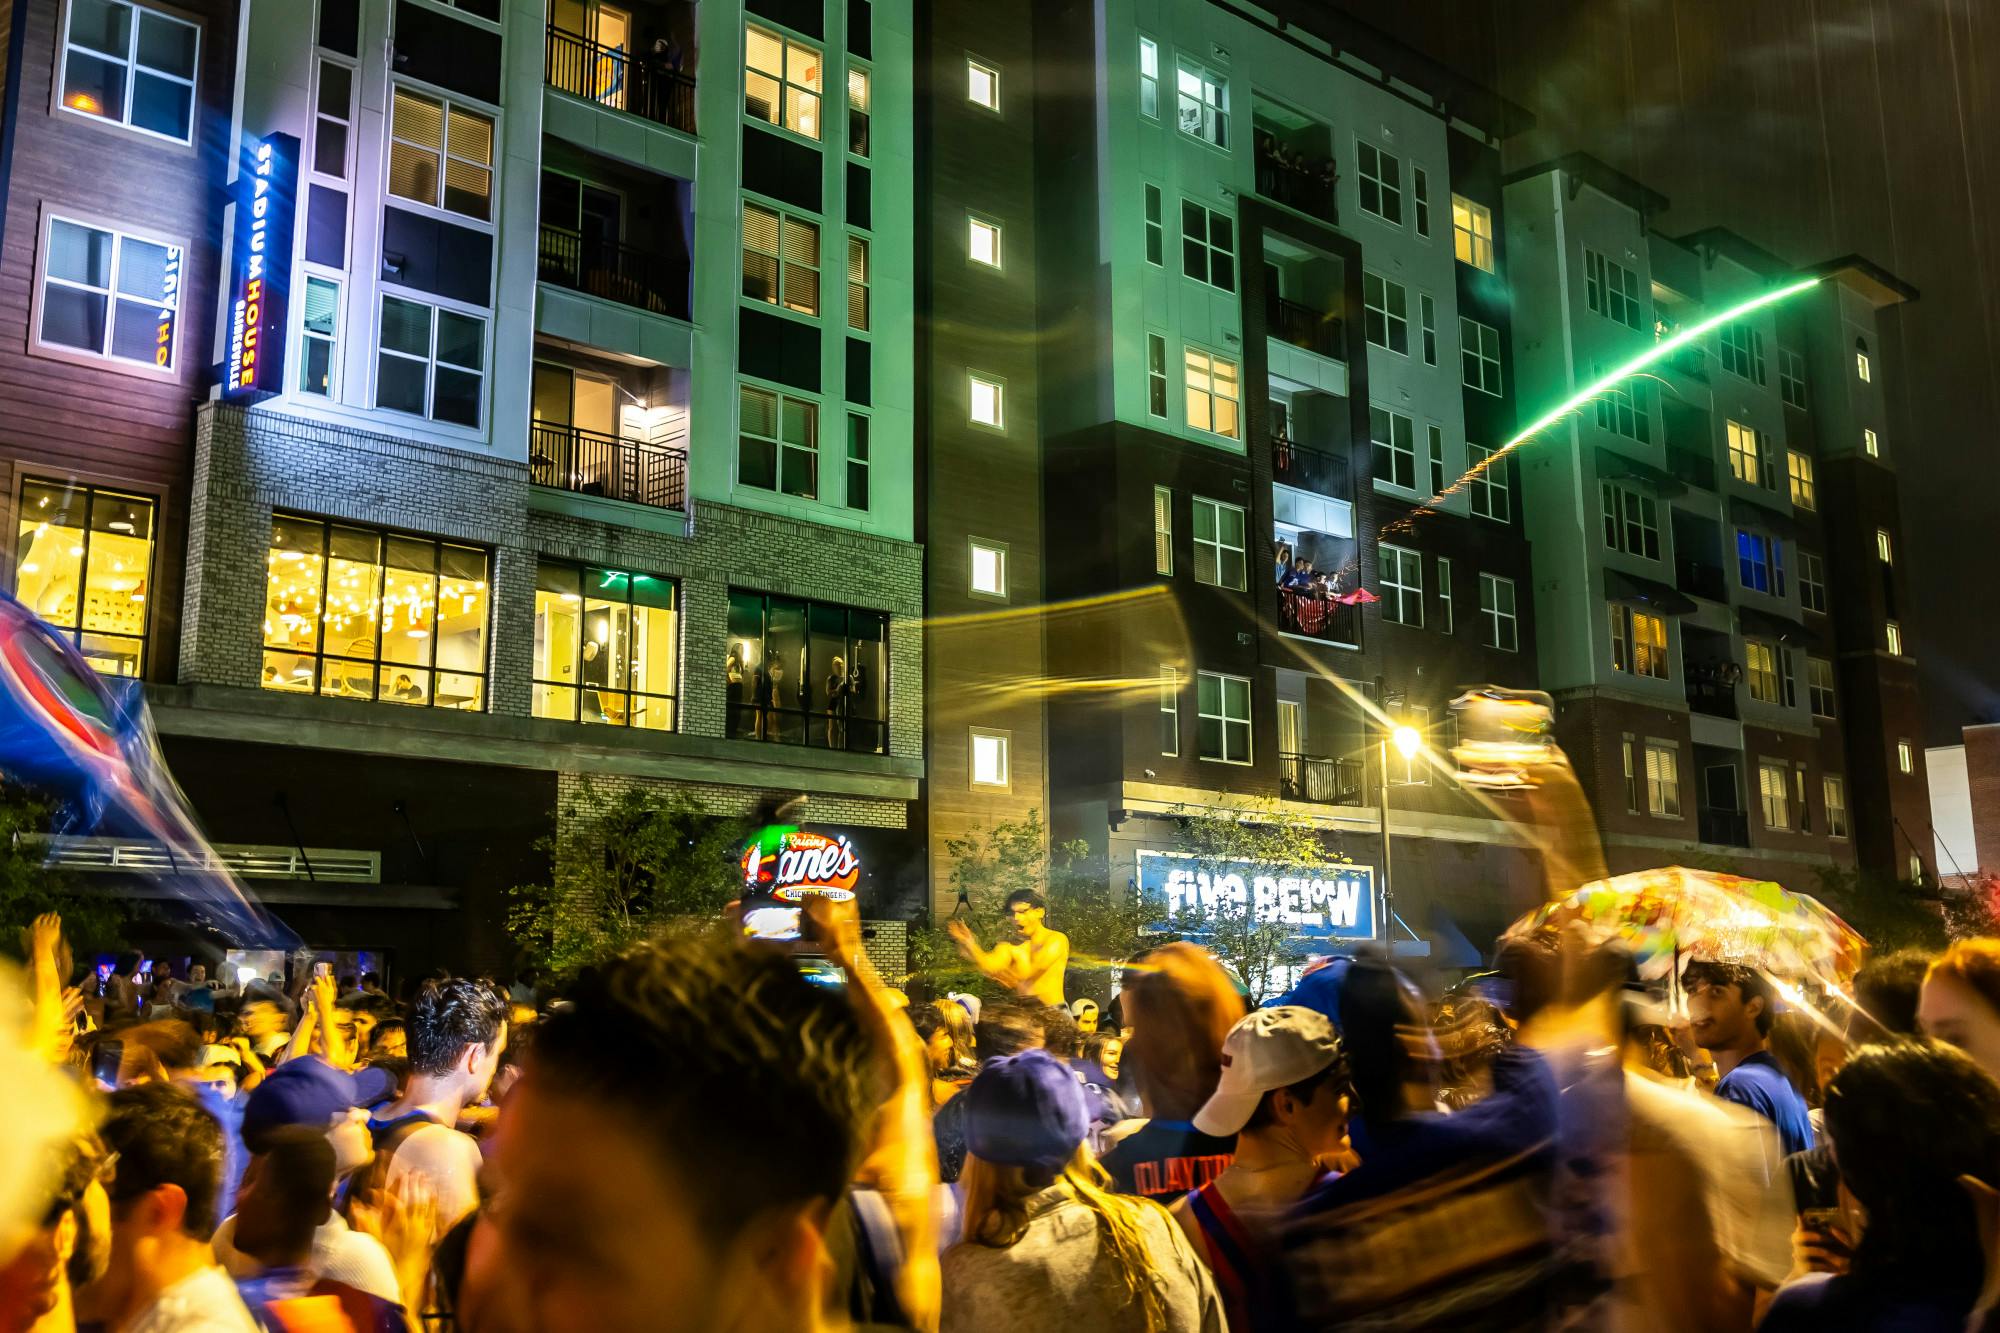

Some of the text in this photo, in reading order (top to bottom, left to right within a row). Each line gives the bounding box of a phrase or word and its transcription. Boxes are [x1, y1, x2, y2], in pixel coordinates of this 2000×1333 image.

[787, 834, 828, 851] Raising
[1164, 869, 1248, 921] five
[1134, 1154, 1235, 1194] CLAYTO
